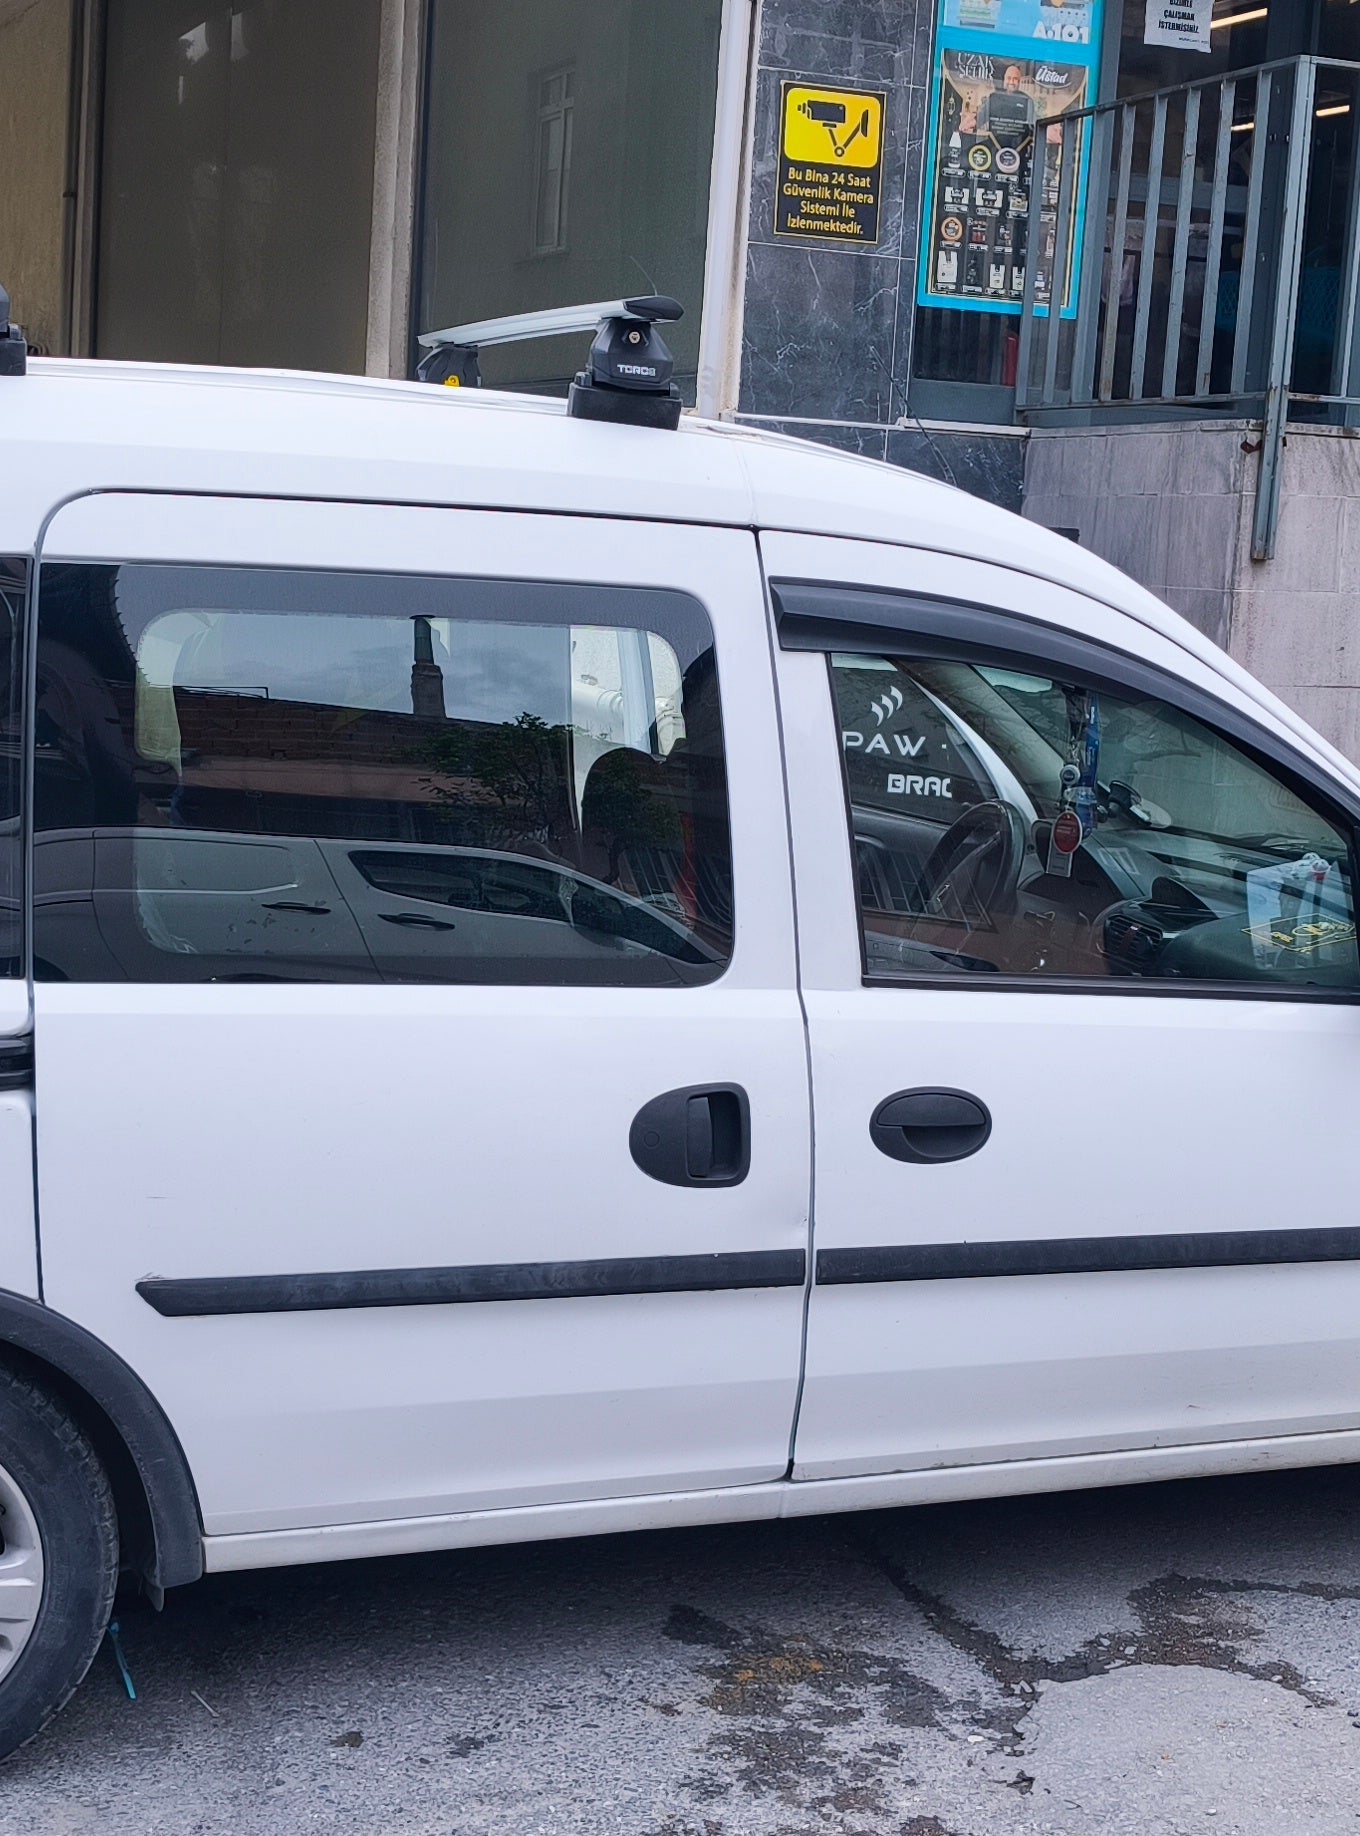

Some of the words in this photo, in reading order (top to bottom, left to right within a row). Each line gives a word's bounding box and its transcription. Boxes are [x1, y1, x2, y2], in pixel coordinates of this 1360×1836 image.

[788, 167, 802, 180] Bu
[805, 169, 829, 183] Bina
[831, 172, 845, 185] 24
[847, 173, 871, 188] Saat
[783, 183, 831, 200] Güvenlik
[833, 188, 874, 204] Kamera
[800, 200, 840, 216] Sistemi
[842, 731, 927, 757] PAW
